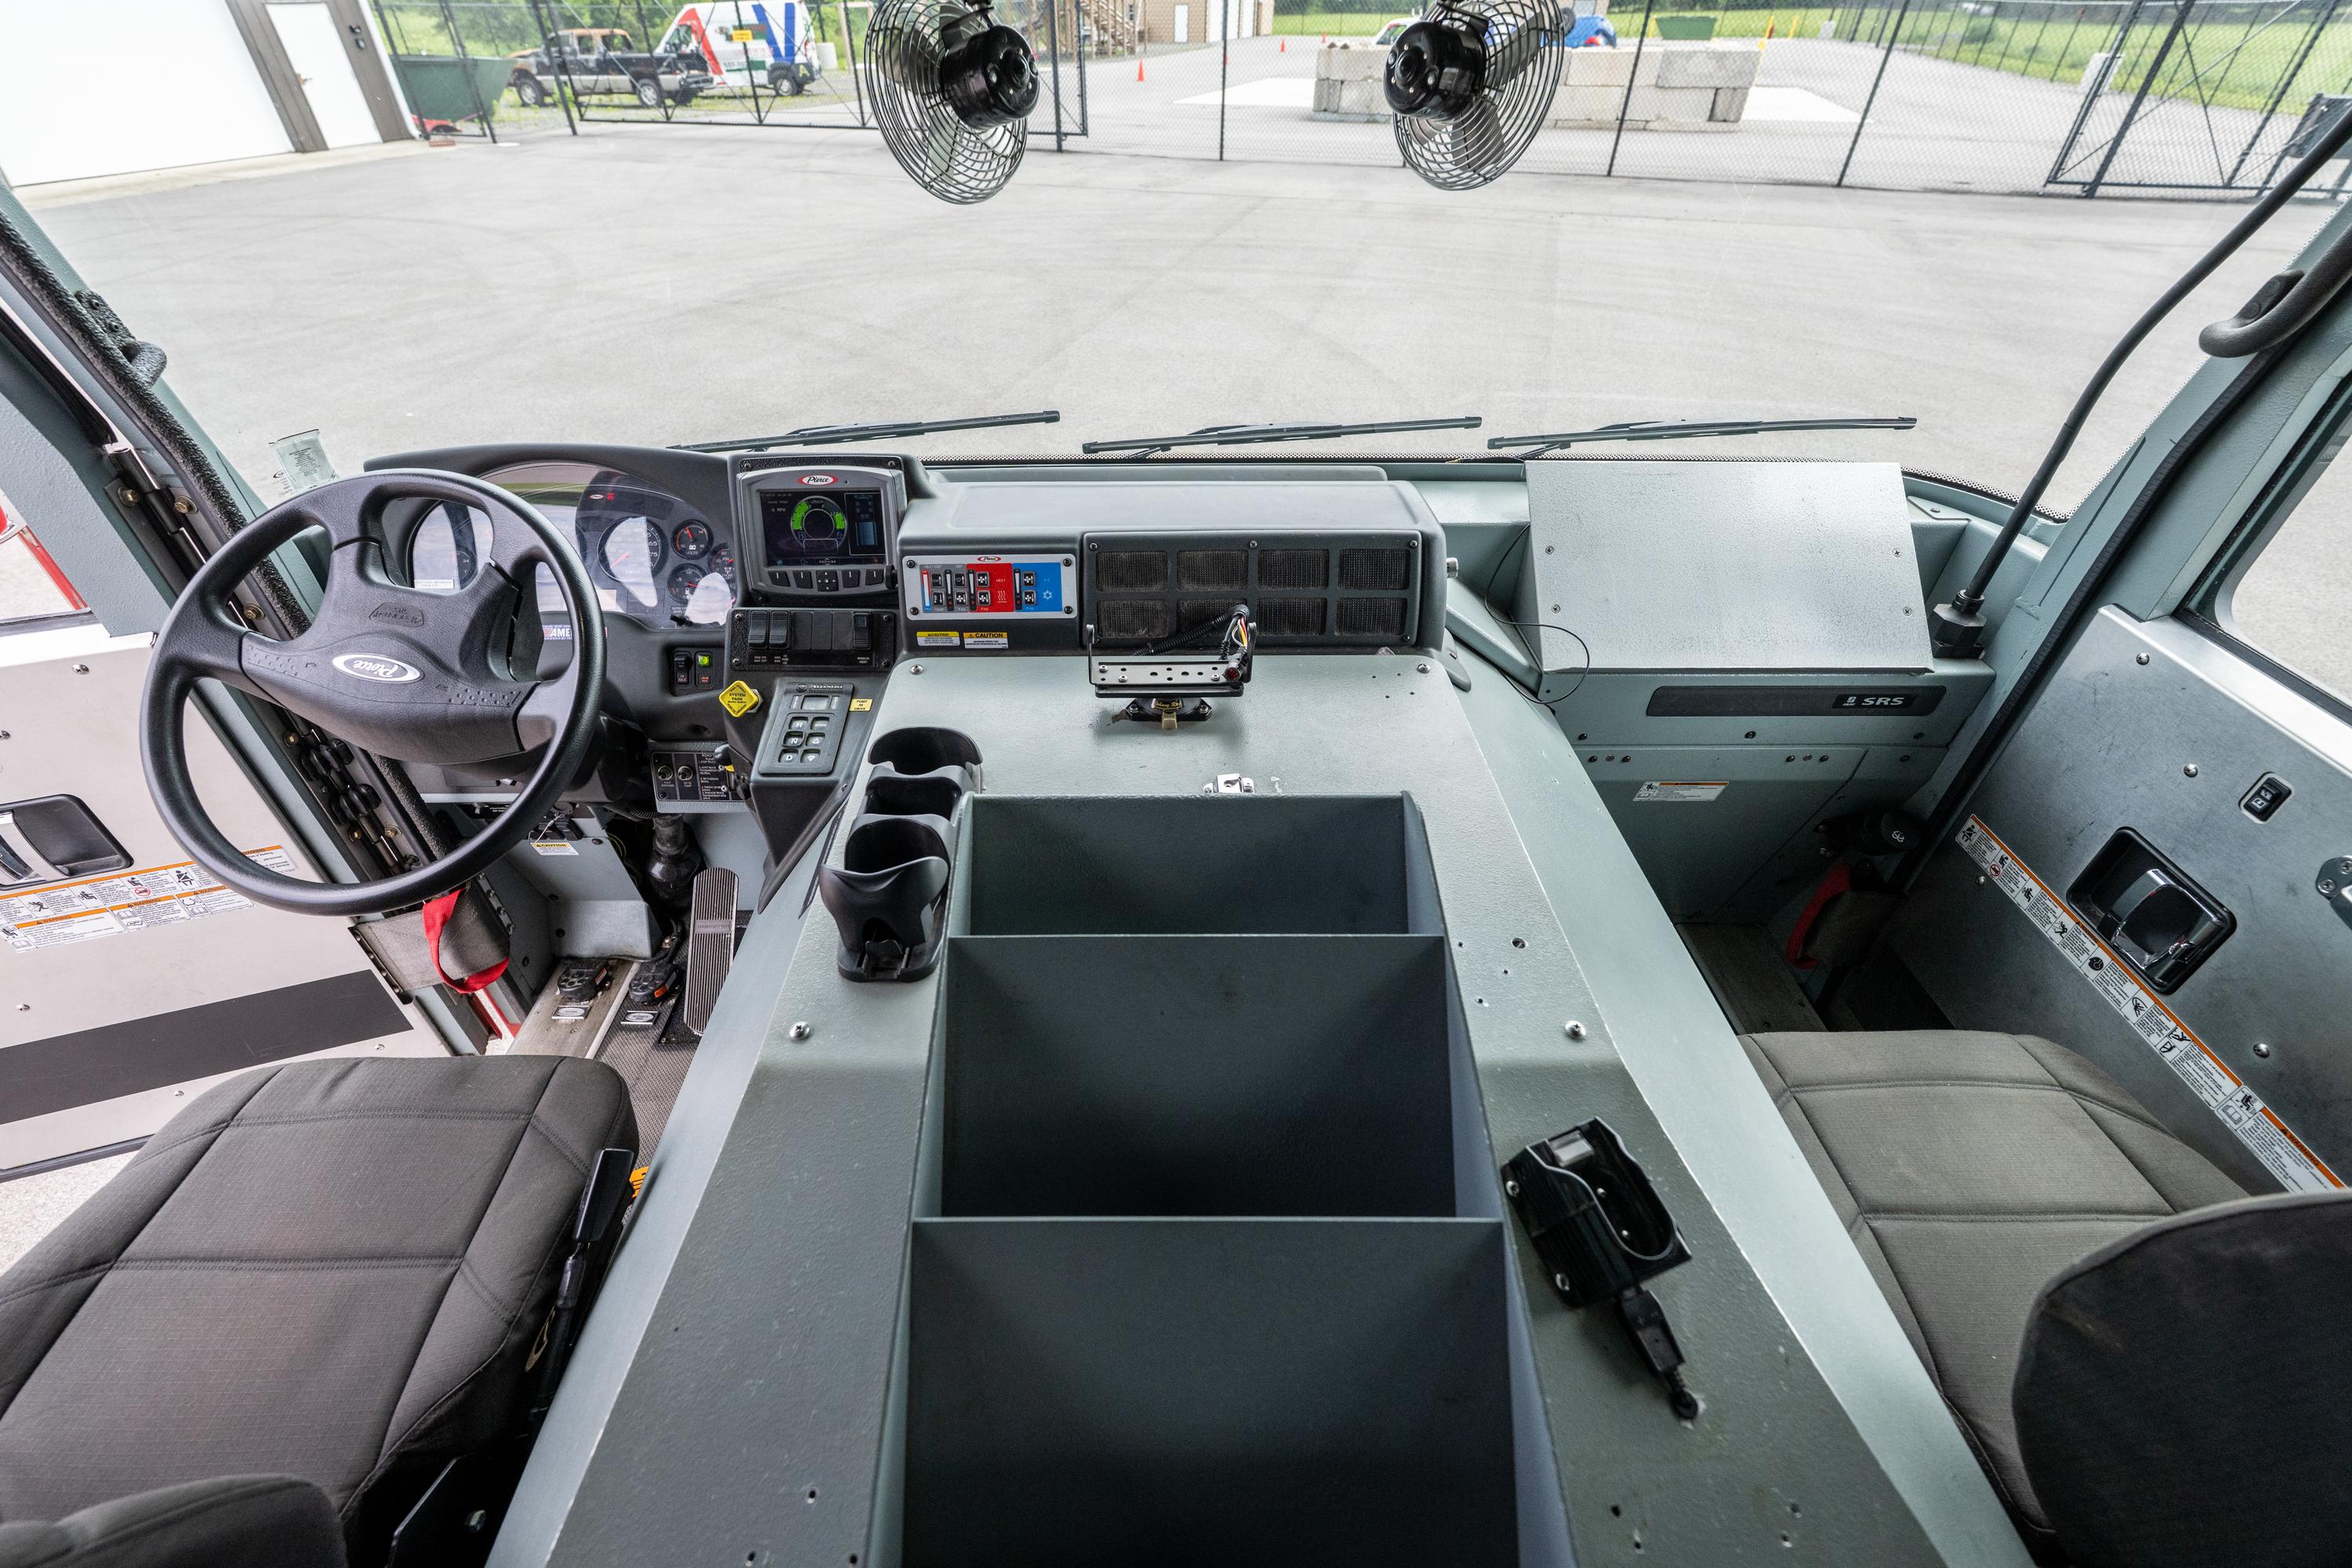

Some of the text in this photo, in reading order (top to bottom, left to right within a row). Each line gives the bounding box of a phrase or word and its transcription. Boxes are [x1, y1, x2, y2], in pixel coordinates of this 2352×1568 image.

[354, 659, 399, 677] Pierce
[1861, 697, 1905, 706] SRS
[199, 885, 227, 894] WARNING
[133, 898, 162, 907] WARNING
[43, 915, 72, 924] WARNING
[2288, 1133, 2319, 1167] WARNING
